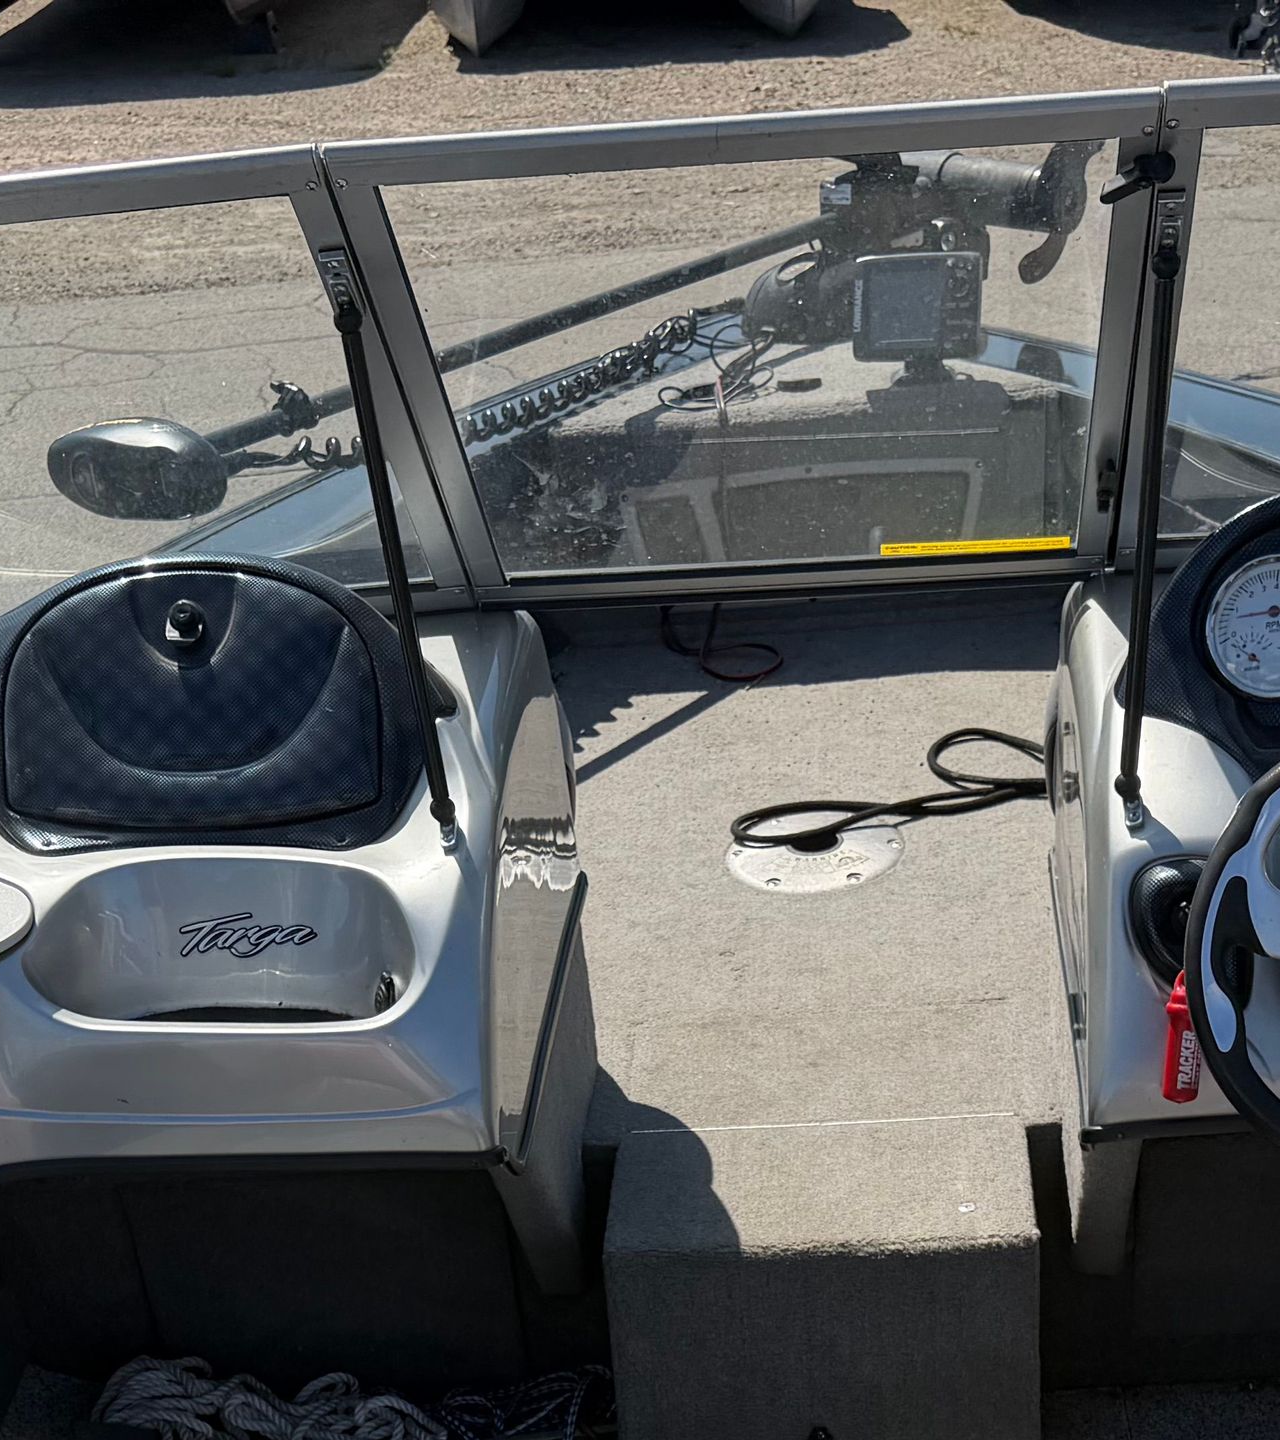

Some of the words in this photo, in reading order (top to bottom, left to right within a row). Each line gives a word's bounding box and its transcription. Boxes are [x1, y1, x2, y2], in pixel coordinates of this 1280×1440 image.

[853, 280, 863, 332] LOWRANCE
[179, 912, 318, 958] Targa
[1177, 1030, 1196, 1090] TRACKER
